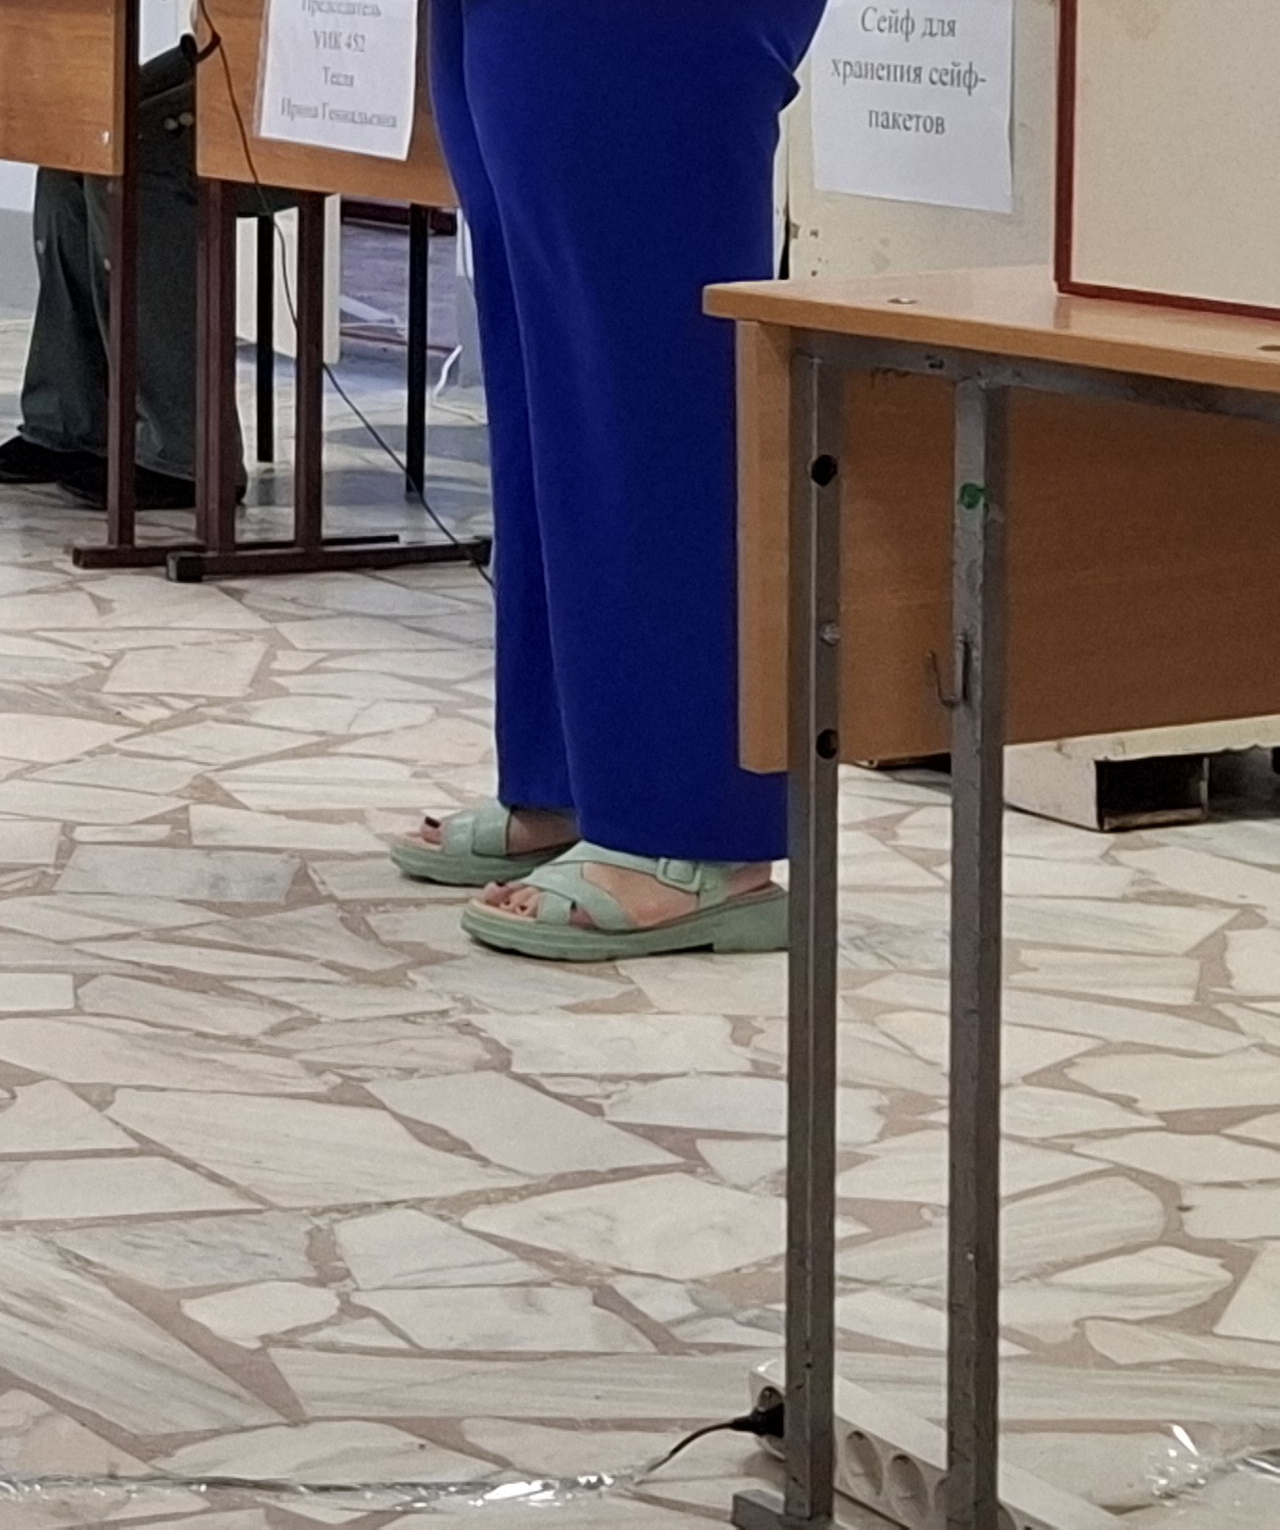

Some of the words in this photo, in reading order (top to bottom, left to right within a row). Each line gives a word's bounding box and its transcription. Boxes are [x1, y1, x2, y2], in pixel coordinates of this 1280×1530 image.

[861, 6, 916, 41] Сейф
[921, 16, 957, 38] для
[831, 58, 923, 86] хранения
[928, 61, 987, 96] сейф-
[868, 108, 946, 135] пакетов
